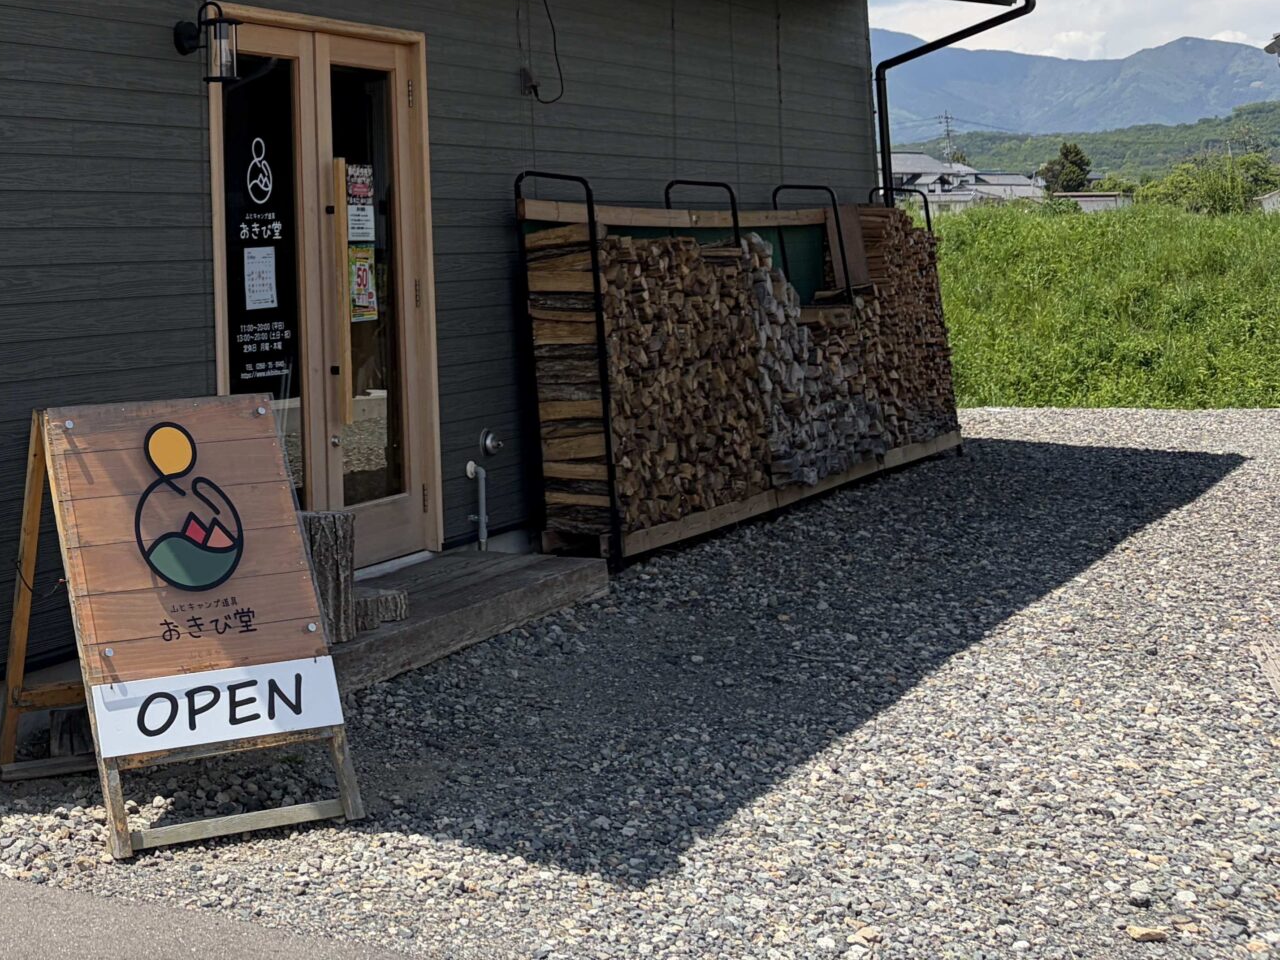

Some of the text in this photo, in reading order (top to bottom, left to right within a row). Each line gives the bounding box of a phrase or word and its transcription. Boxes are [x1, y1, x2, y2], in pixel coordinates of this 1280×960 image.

[239, 221, 283, 240] おきび堂
[170, 596, 238, 614] 山とキャンプ道具
[159, 607, 258, 642] おきび堂
[136, 672, 303, 737] OPEN
